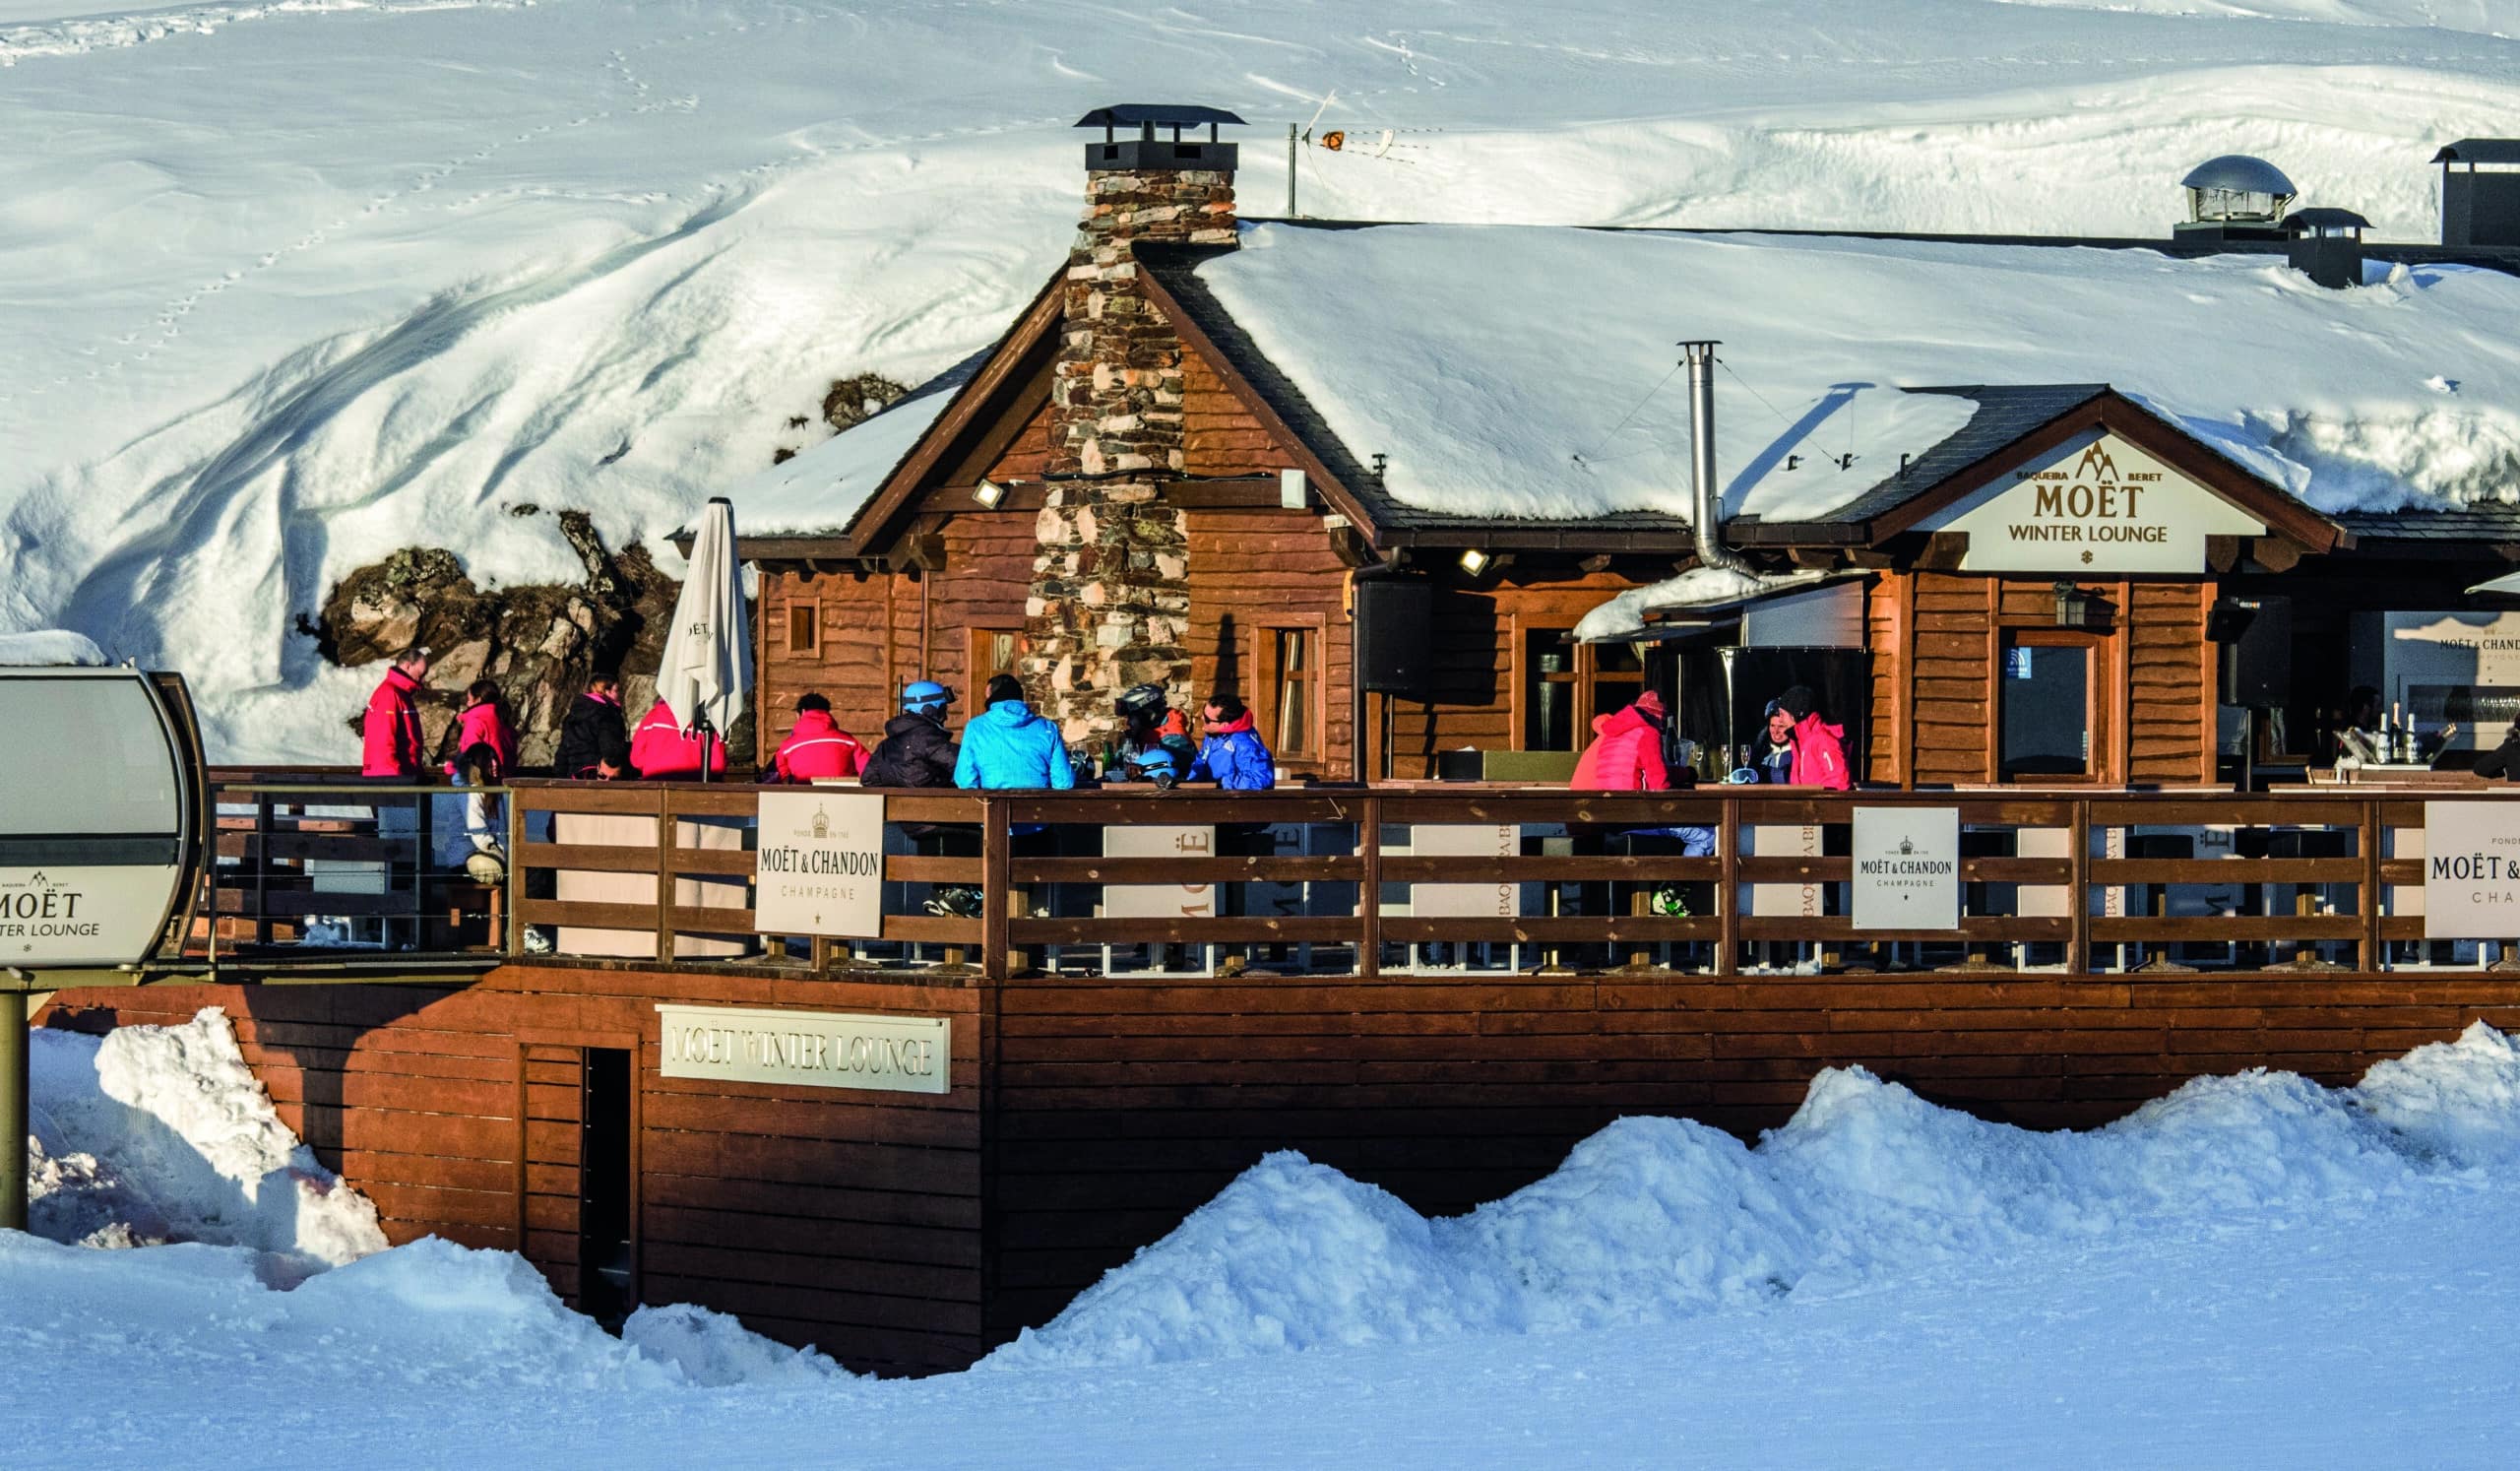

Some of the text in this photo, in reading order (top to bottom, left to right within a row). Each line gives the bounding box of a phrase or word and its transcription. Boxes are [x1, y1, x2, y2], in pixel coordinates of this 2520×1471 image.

[2017, 472, 2163, 481] BAQUEIRA BERET
[2033, 480, 2144, 518] MOËT
[2008, 525, 2168, 543] WINTER LOUNGE
[760, 845, 878, 876] MOËT & CHANDON
[1860, 859, 1952, 874] MOËT & CHANDON
[2431, 852, 2501, 880] MOËT
[781, 885, 854, 901] CHAMPAGNE
[31, 923, 100, 937] LOUNGE
[740, 1029, 829, 1070] WINTER
[837, 1035, 932, 1076] LOUNGE
